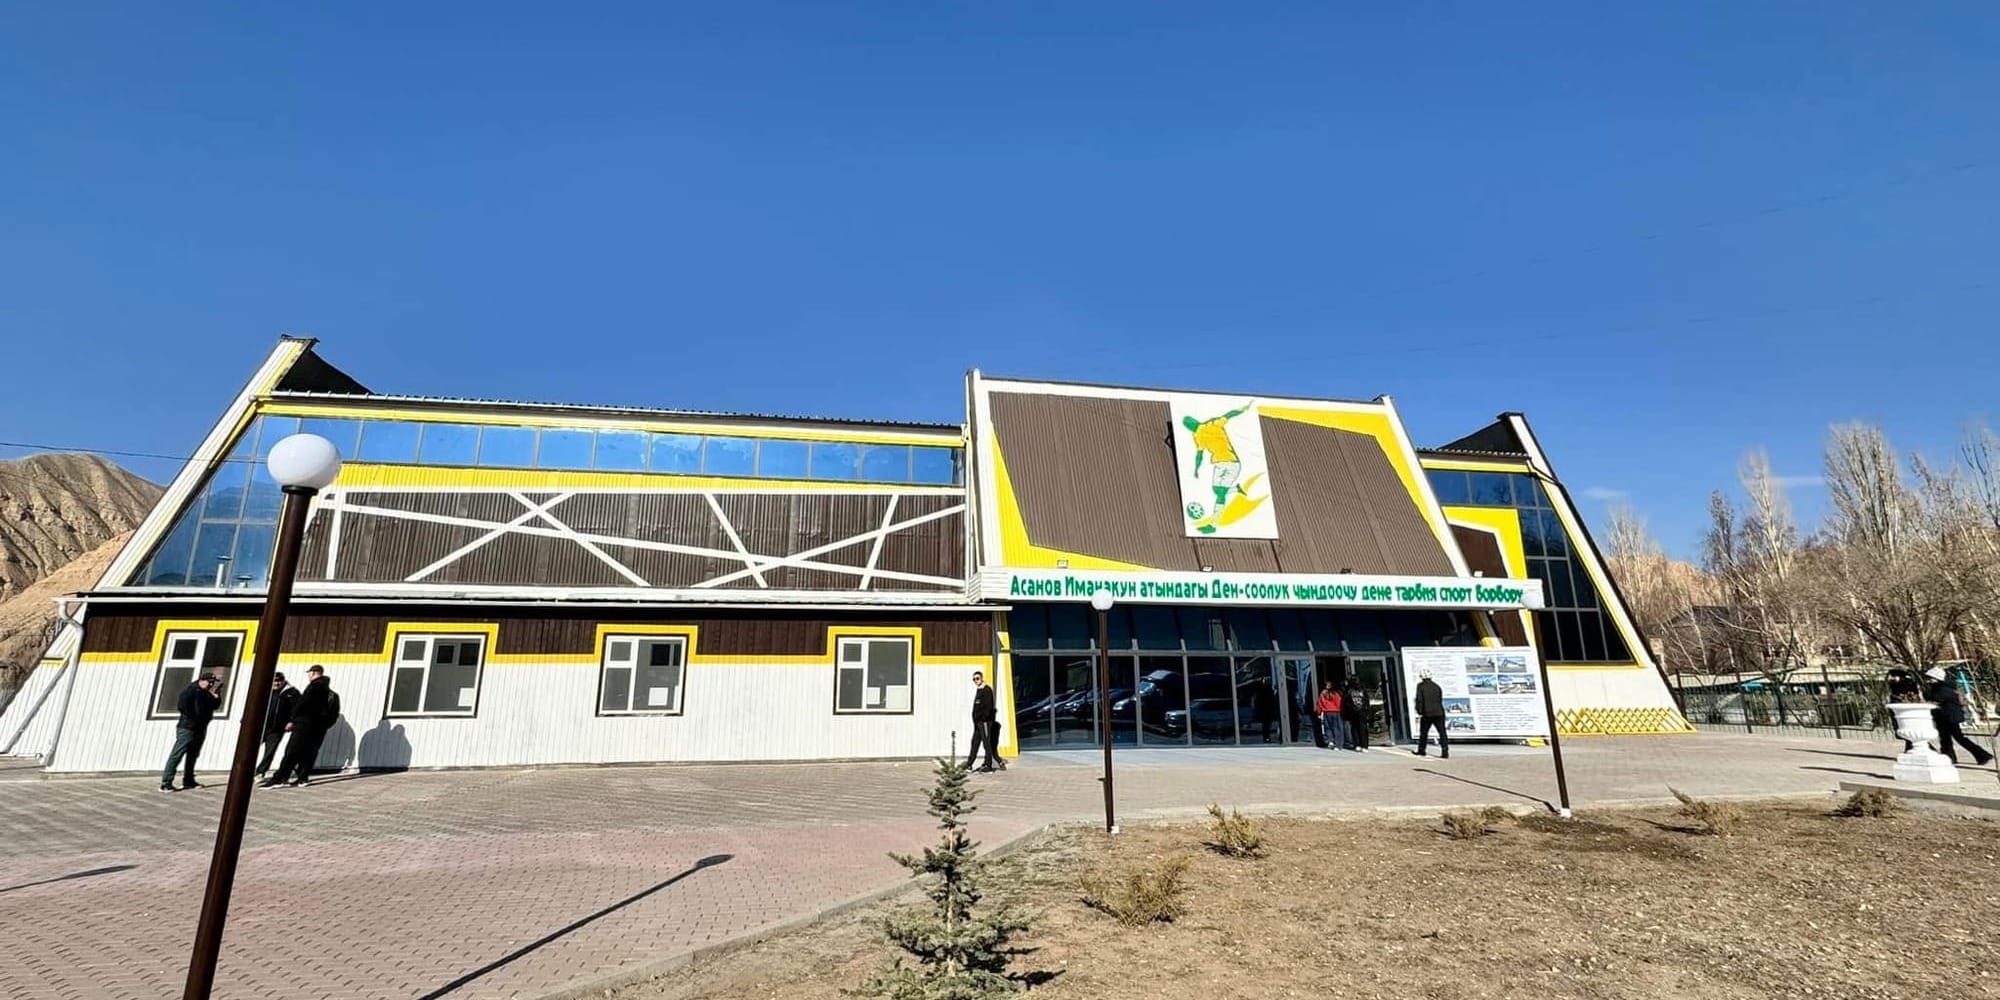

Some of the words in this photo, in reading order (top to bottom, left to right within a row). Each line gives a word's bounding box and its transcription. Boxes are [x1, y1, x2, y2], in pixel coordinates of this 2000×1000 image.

[1010, 575, 1062, 597] Асанов
[1140, 581, 1209, 599] атындагы
[1211, 579, 1290, 600] Ден-соолук
[1292, 584, 1358, 601] чындоочу
[1362, 585, 1393, 601] дене
[1395, 582, 1438, 602] тарбия
[1439, 586, 1473, 603] спорт
